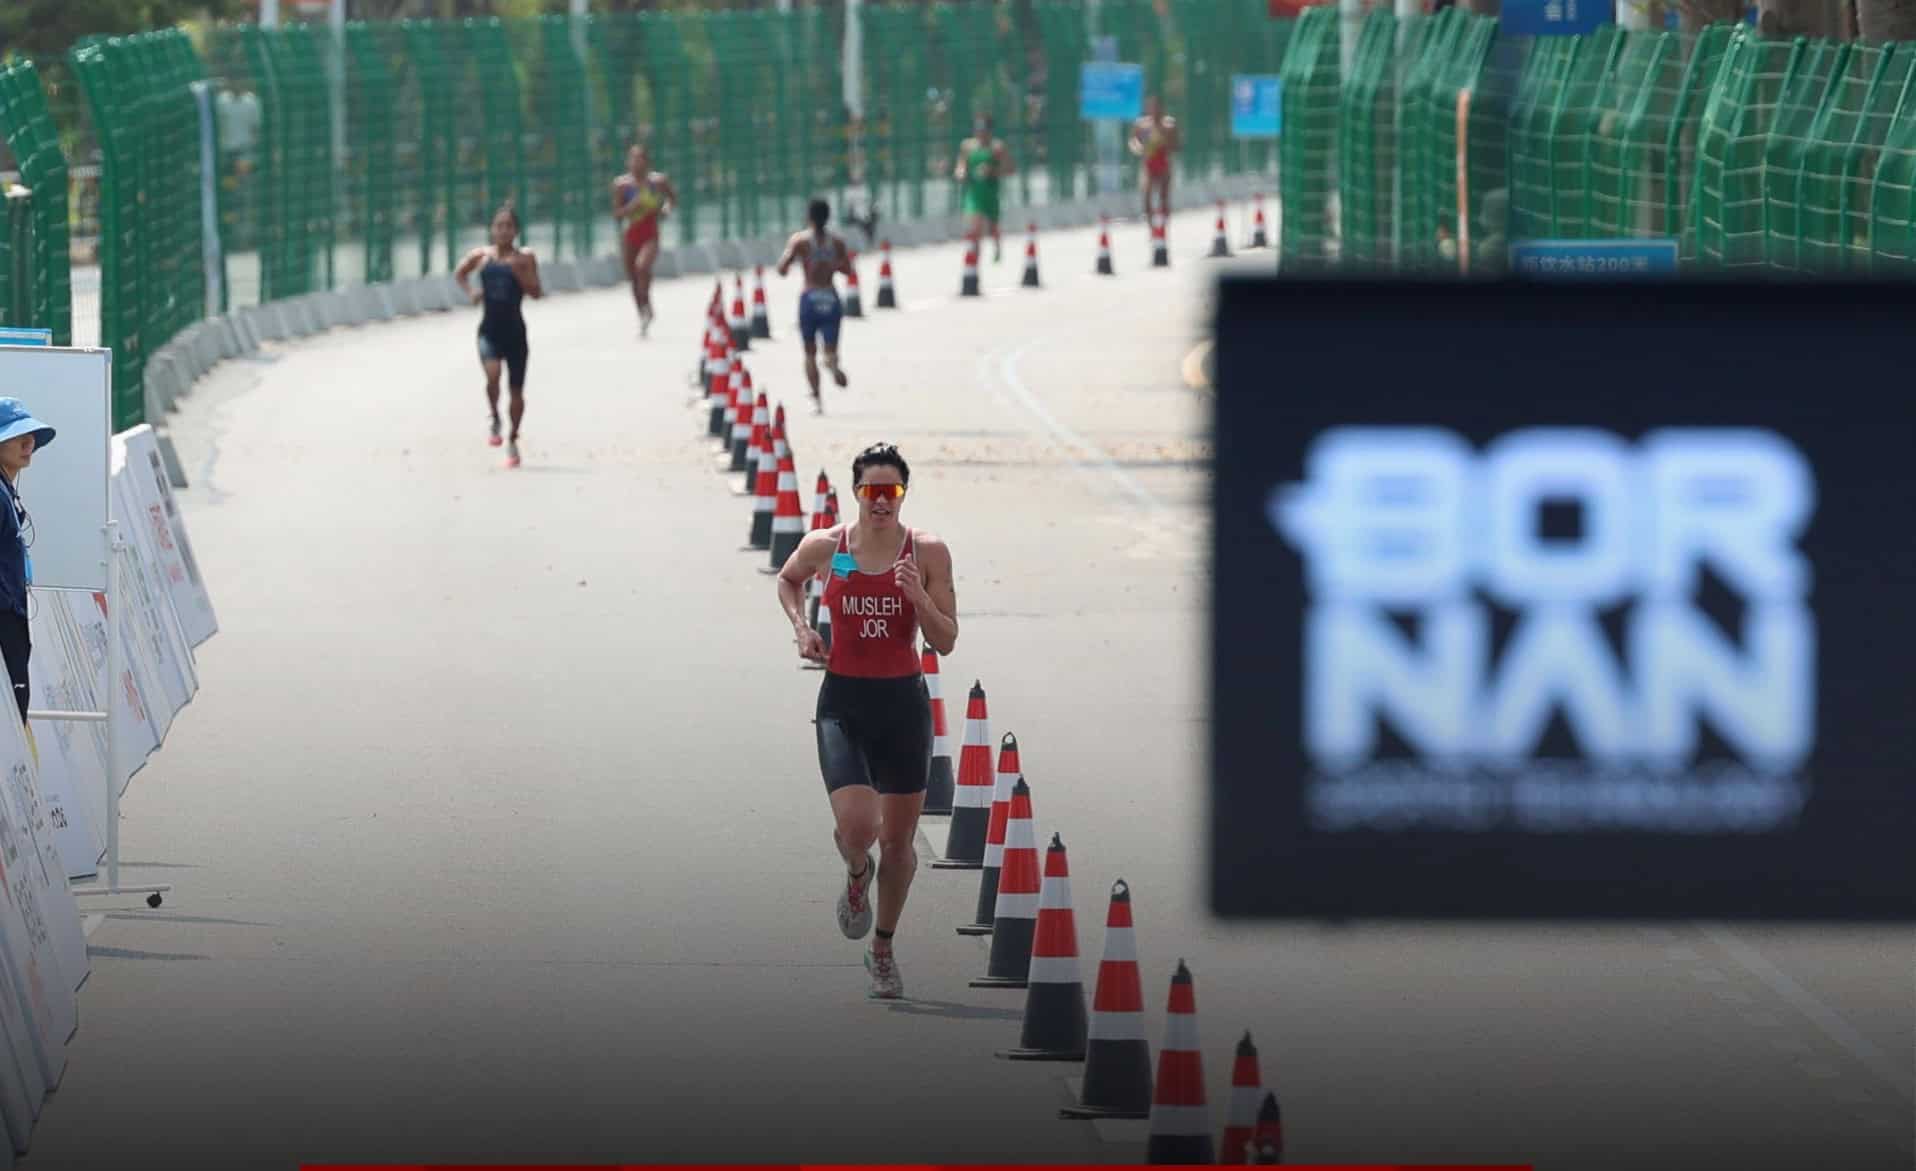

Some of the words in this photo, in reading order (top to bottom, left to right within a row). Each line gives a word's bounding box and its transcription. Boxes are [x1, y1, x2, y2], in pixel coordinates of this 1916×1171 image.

[1270, 426, 1816, 606] BOR
[843, 596, 902, 615] MUSLEH
[860, 619, 889, 638] JOR
[1304, 598, 1816, 772] NAN
